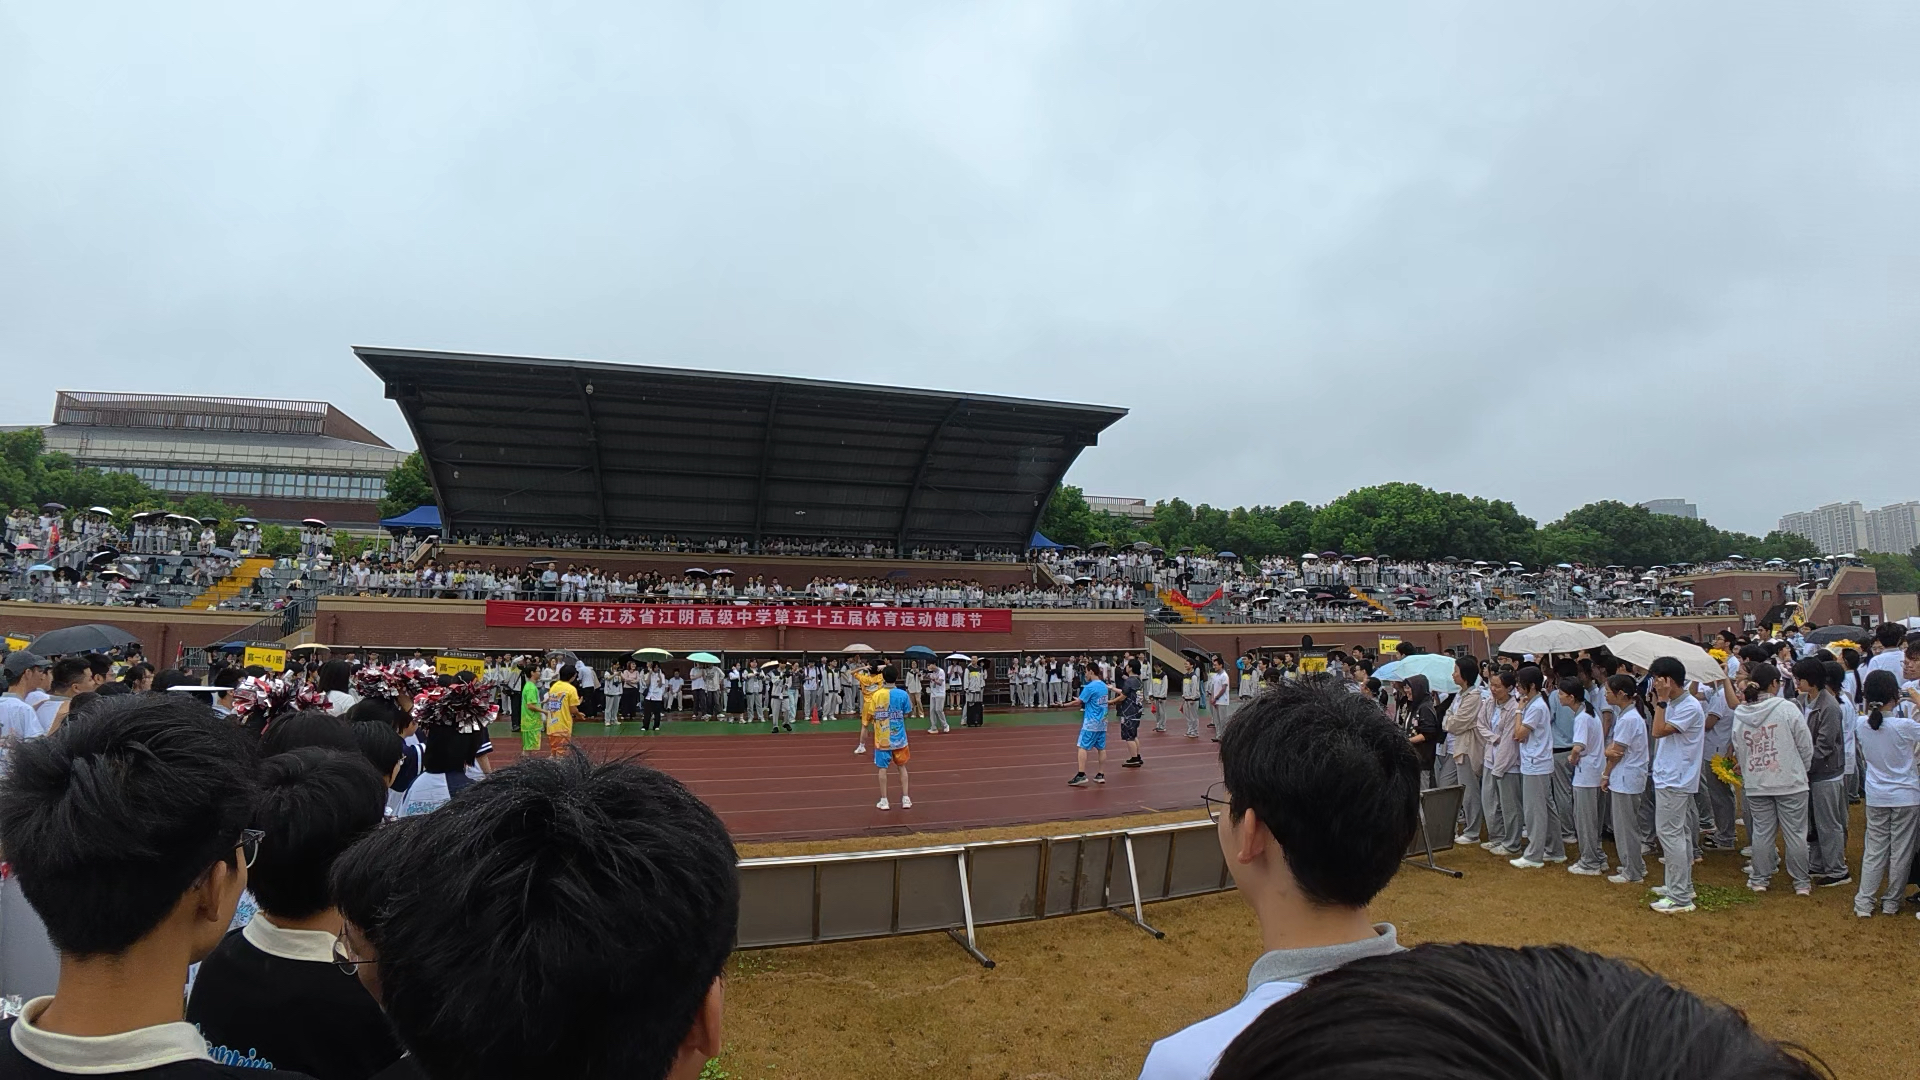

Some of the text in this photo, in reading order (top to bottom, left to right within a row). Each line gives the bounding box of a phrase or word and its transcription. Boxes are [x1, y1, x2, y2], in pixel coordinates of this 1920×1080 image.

[524, 607, 983, 628] 2026年江苏省江阴高级中学第五十五届体育运动健康节
